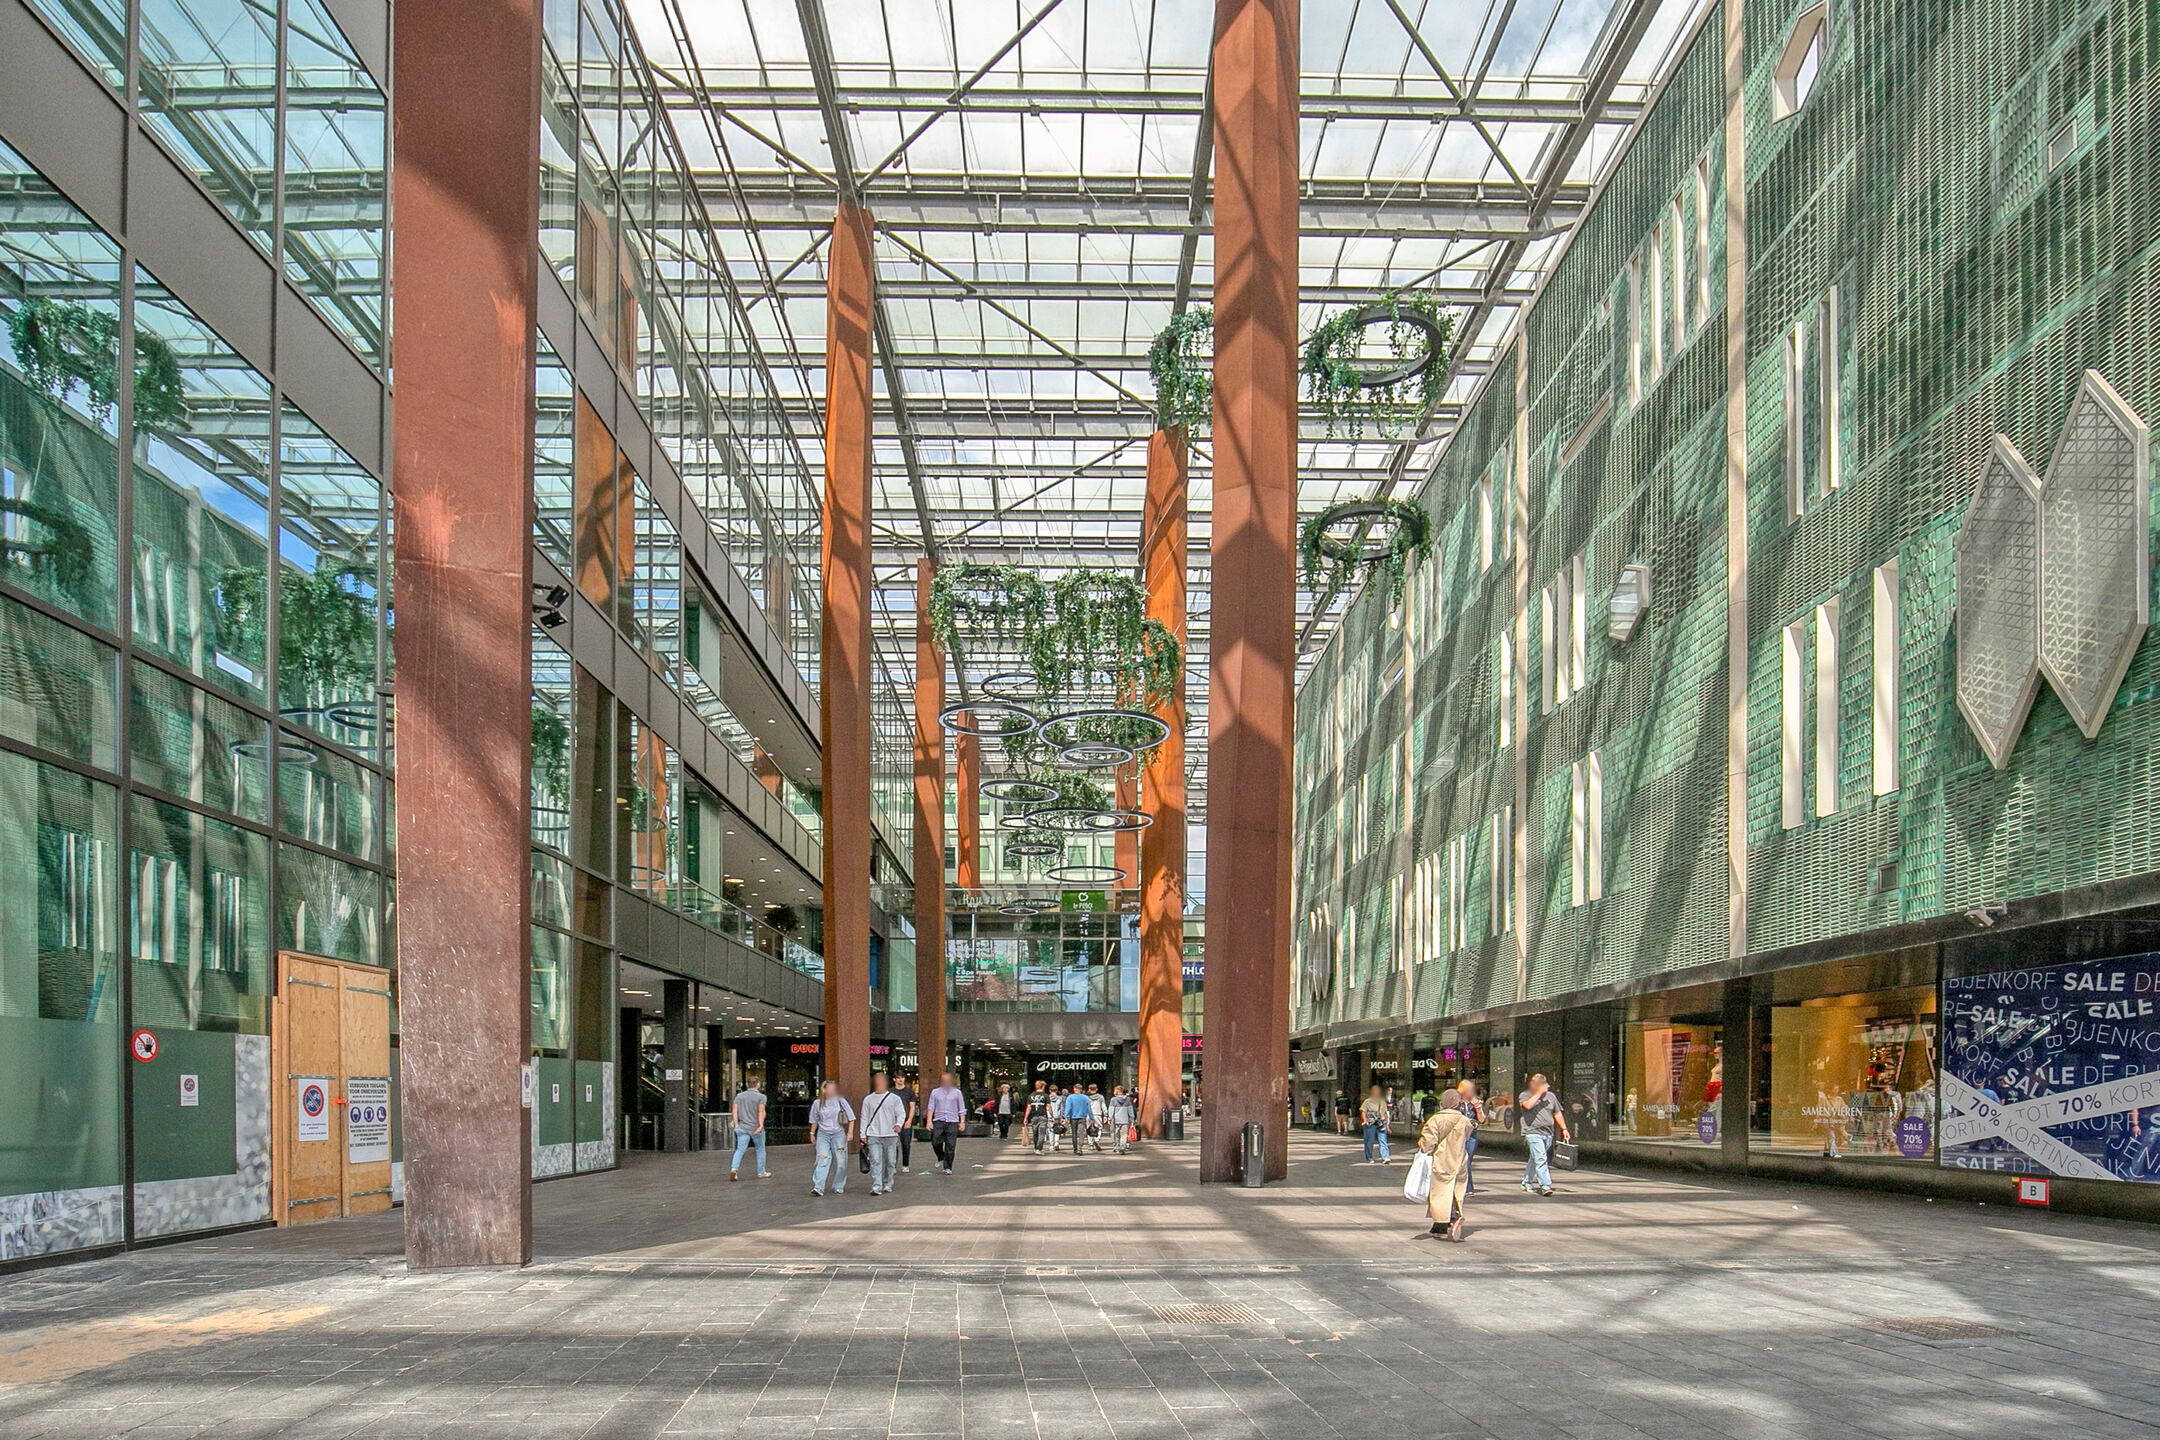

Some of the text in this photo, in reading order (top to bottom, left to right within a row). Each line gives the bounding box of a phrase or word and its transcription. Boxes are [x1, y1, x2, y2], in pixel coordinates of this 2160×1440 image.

[2063, 972, 2126, 991] SALE
[1970, 1004, 2022, 1029] SALE
[2087, 999, 2153, 1020] SALE
[2065, 1018, 2160, 1052] BIJENKO
[900, 1055, 919, 1066] ONL
[1051, 1062, 1107, 1070] DECATHLON
[1801, 1106, 1830, 1116] SAMEN
[2016, 1102, 2051, 1122] TOT
[2058, 1092, 2102, 1115] 70%
[1903, 1123, 1924, 1131] SALE
[1903, 1134, 1923, 1144] 70%
[1970, 1096, 2002, 1126] 70%
[2005, 1119, 2082, 1177] KORTING
[2030, 1185, 2037, 1196] B
